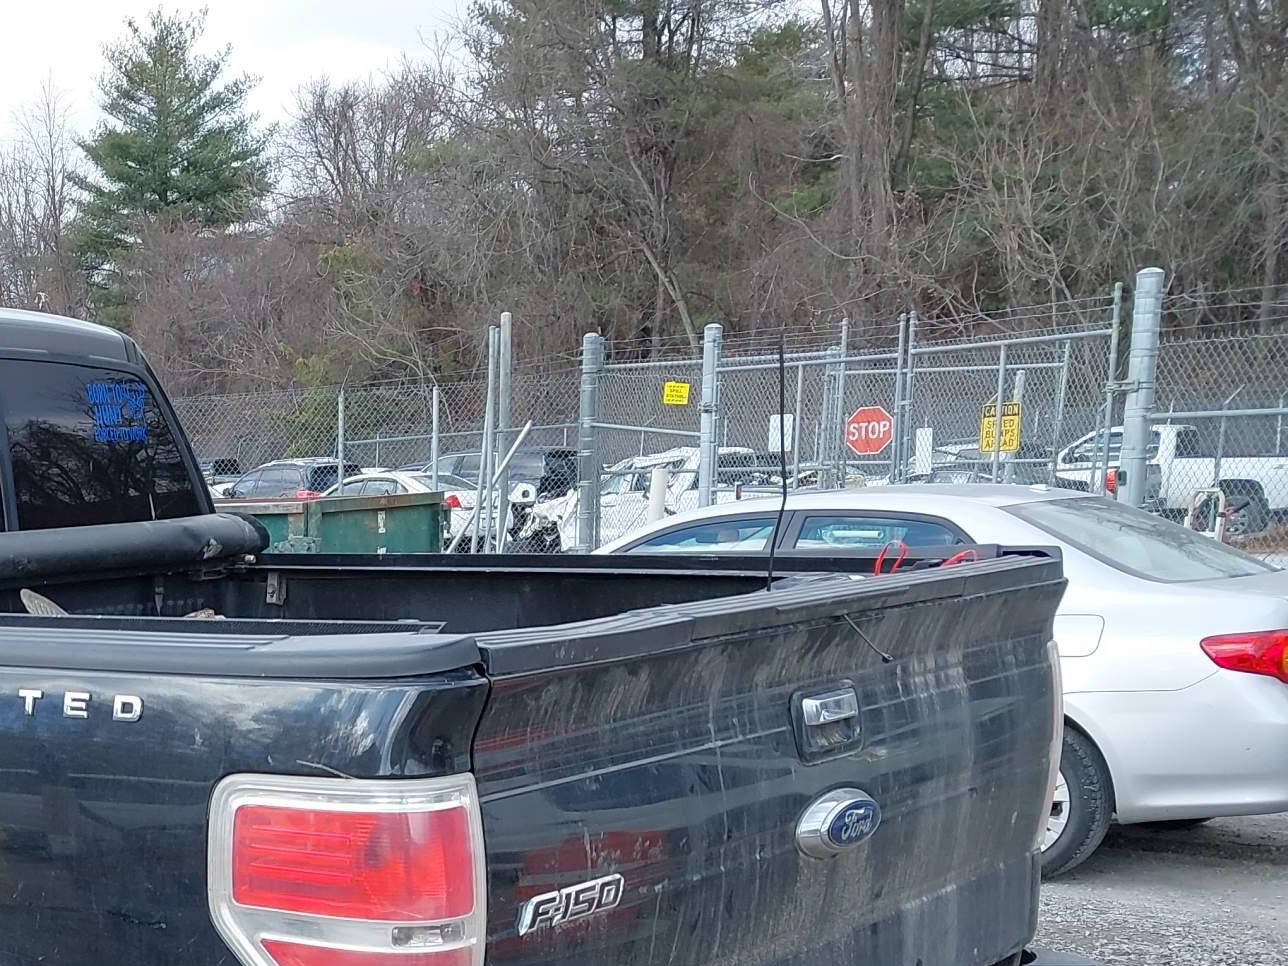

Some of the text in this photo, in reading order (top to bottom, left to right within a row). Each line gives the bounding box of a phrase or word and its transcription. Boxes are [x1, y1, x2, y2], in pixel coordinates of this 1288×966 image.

[87, 383, 123, 404] BORN TO
[95, 405, 122, 426] HUNT
[848, 421, 890, 441] STOP
[841, 806, 874, 841] Ford
